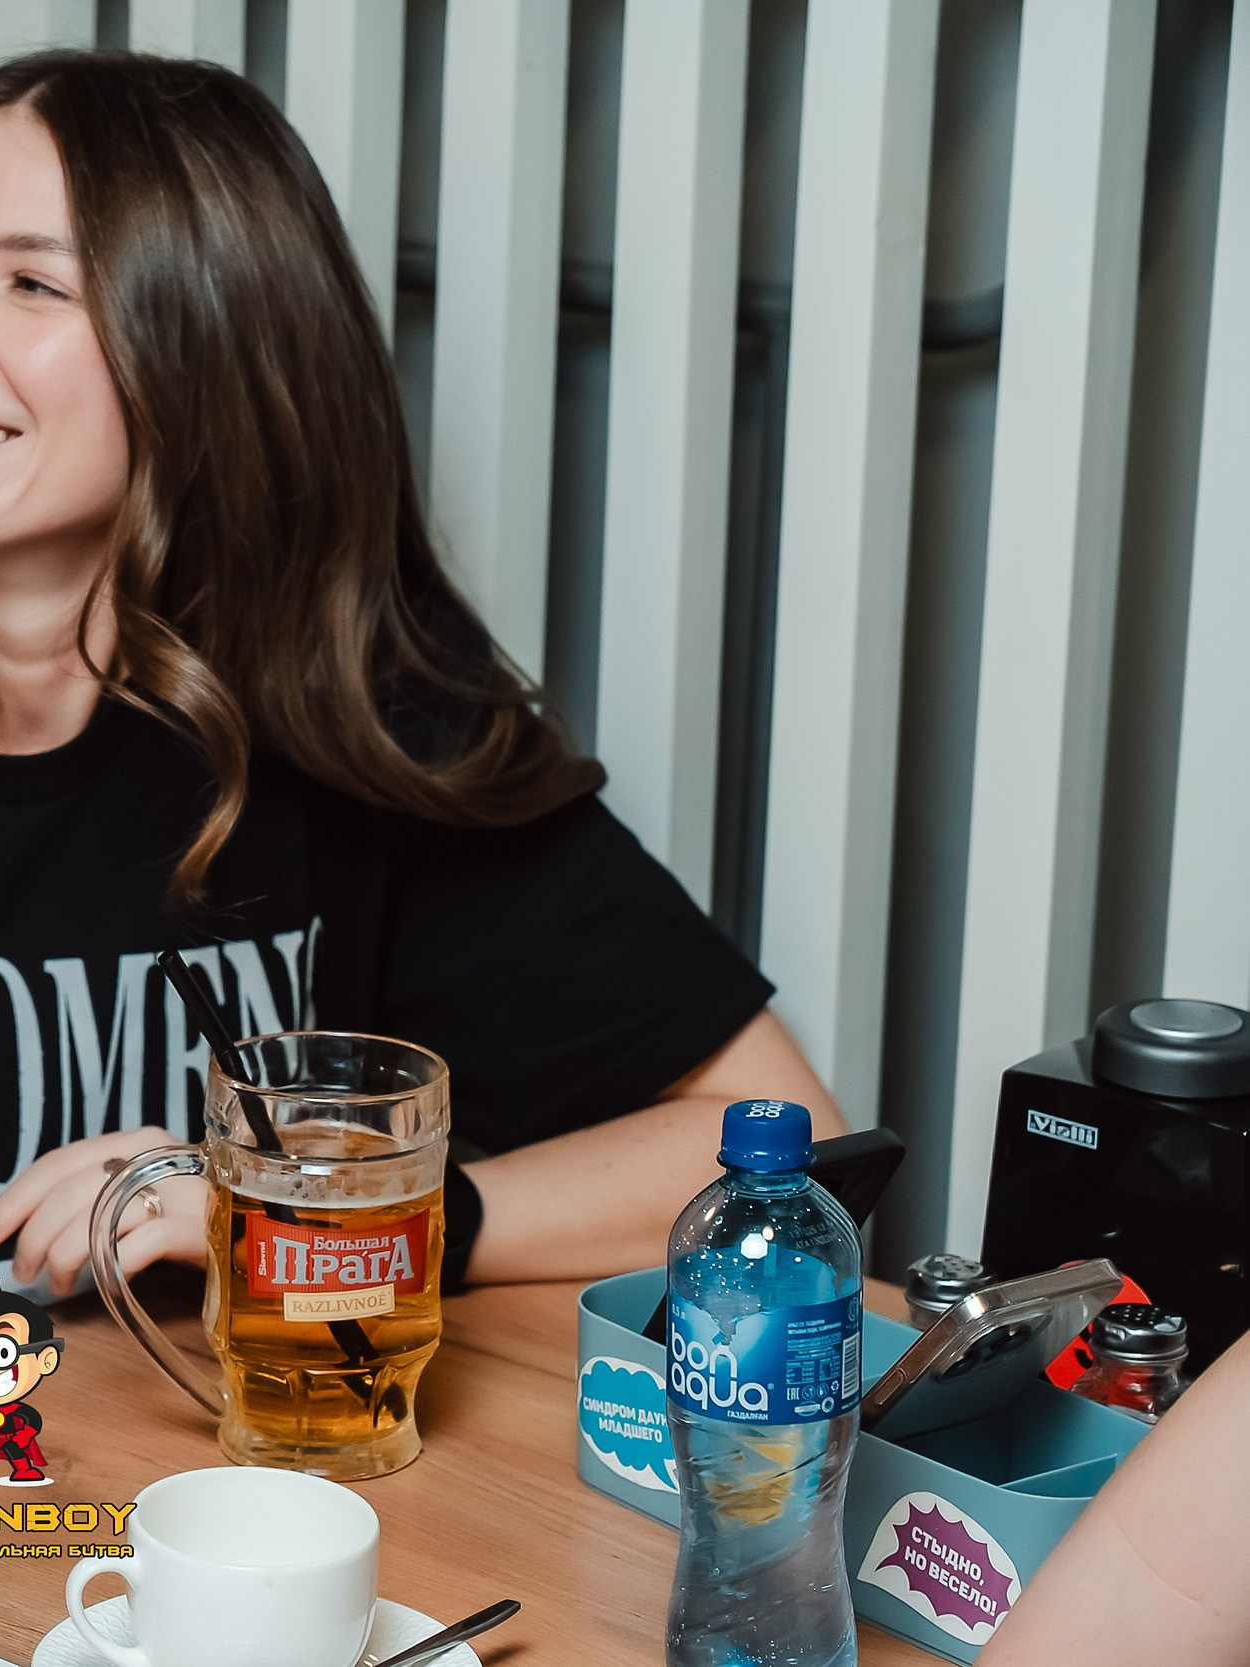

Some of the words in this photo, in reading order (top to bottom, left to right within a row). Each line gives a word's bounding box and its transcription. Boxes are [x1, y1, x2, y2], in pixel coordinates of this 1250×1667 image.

[313, 1236, 390, 1251] Большая
[671, 1322, 738, 1379] bon
[582, 1396, 637, 1421] СИНДРОМ
[598, 1417, 663, 1443] МЛАДШЕГО
[911, 1526, 985, 1587] СТЫДНО,
[904, 1545, 927, 1571] НО
[928, 1561, 998, 1617] ВЕСЕЛО!
